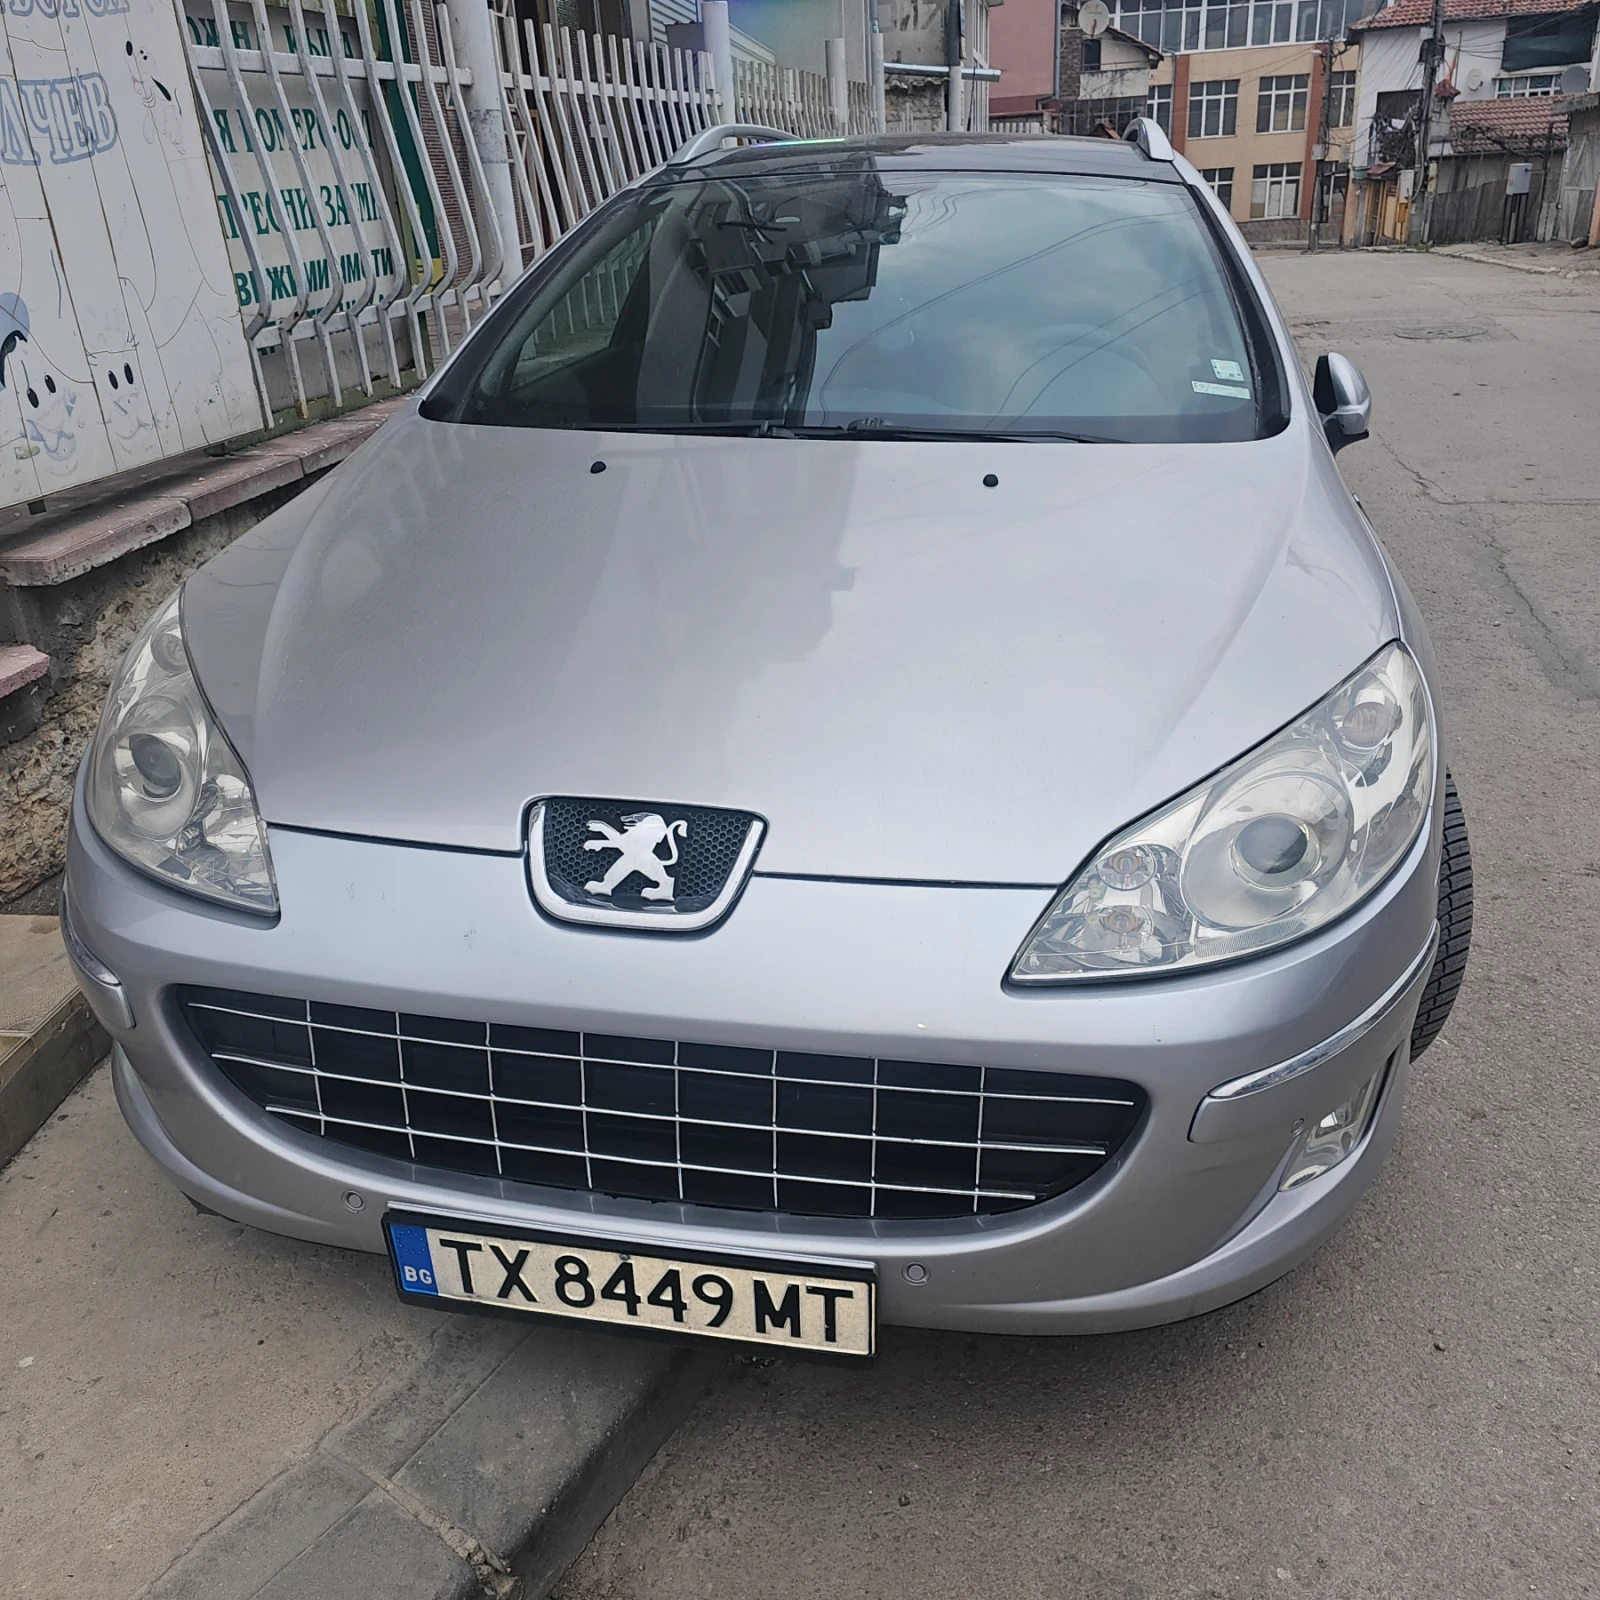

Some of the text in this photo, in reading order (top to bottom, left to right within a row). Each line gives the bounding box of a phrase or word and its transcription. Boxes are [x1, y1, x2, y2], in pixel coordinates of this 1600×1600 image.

[404, 1265, 433, 1285] BG
[439, 1238, 854, 1343] TX 8449 MT
